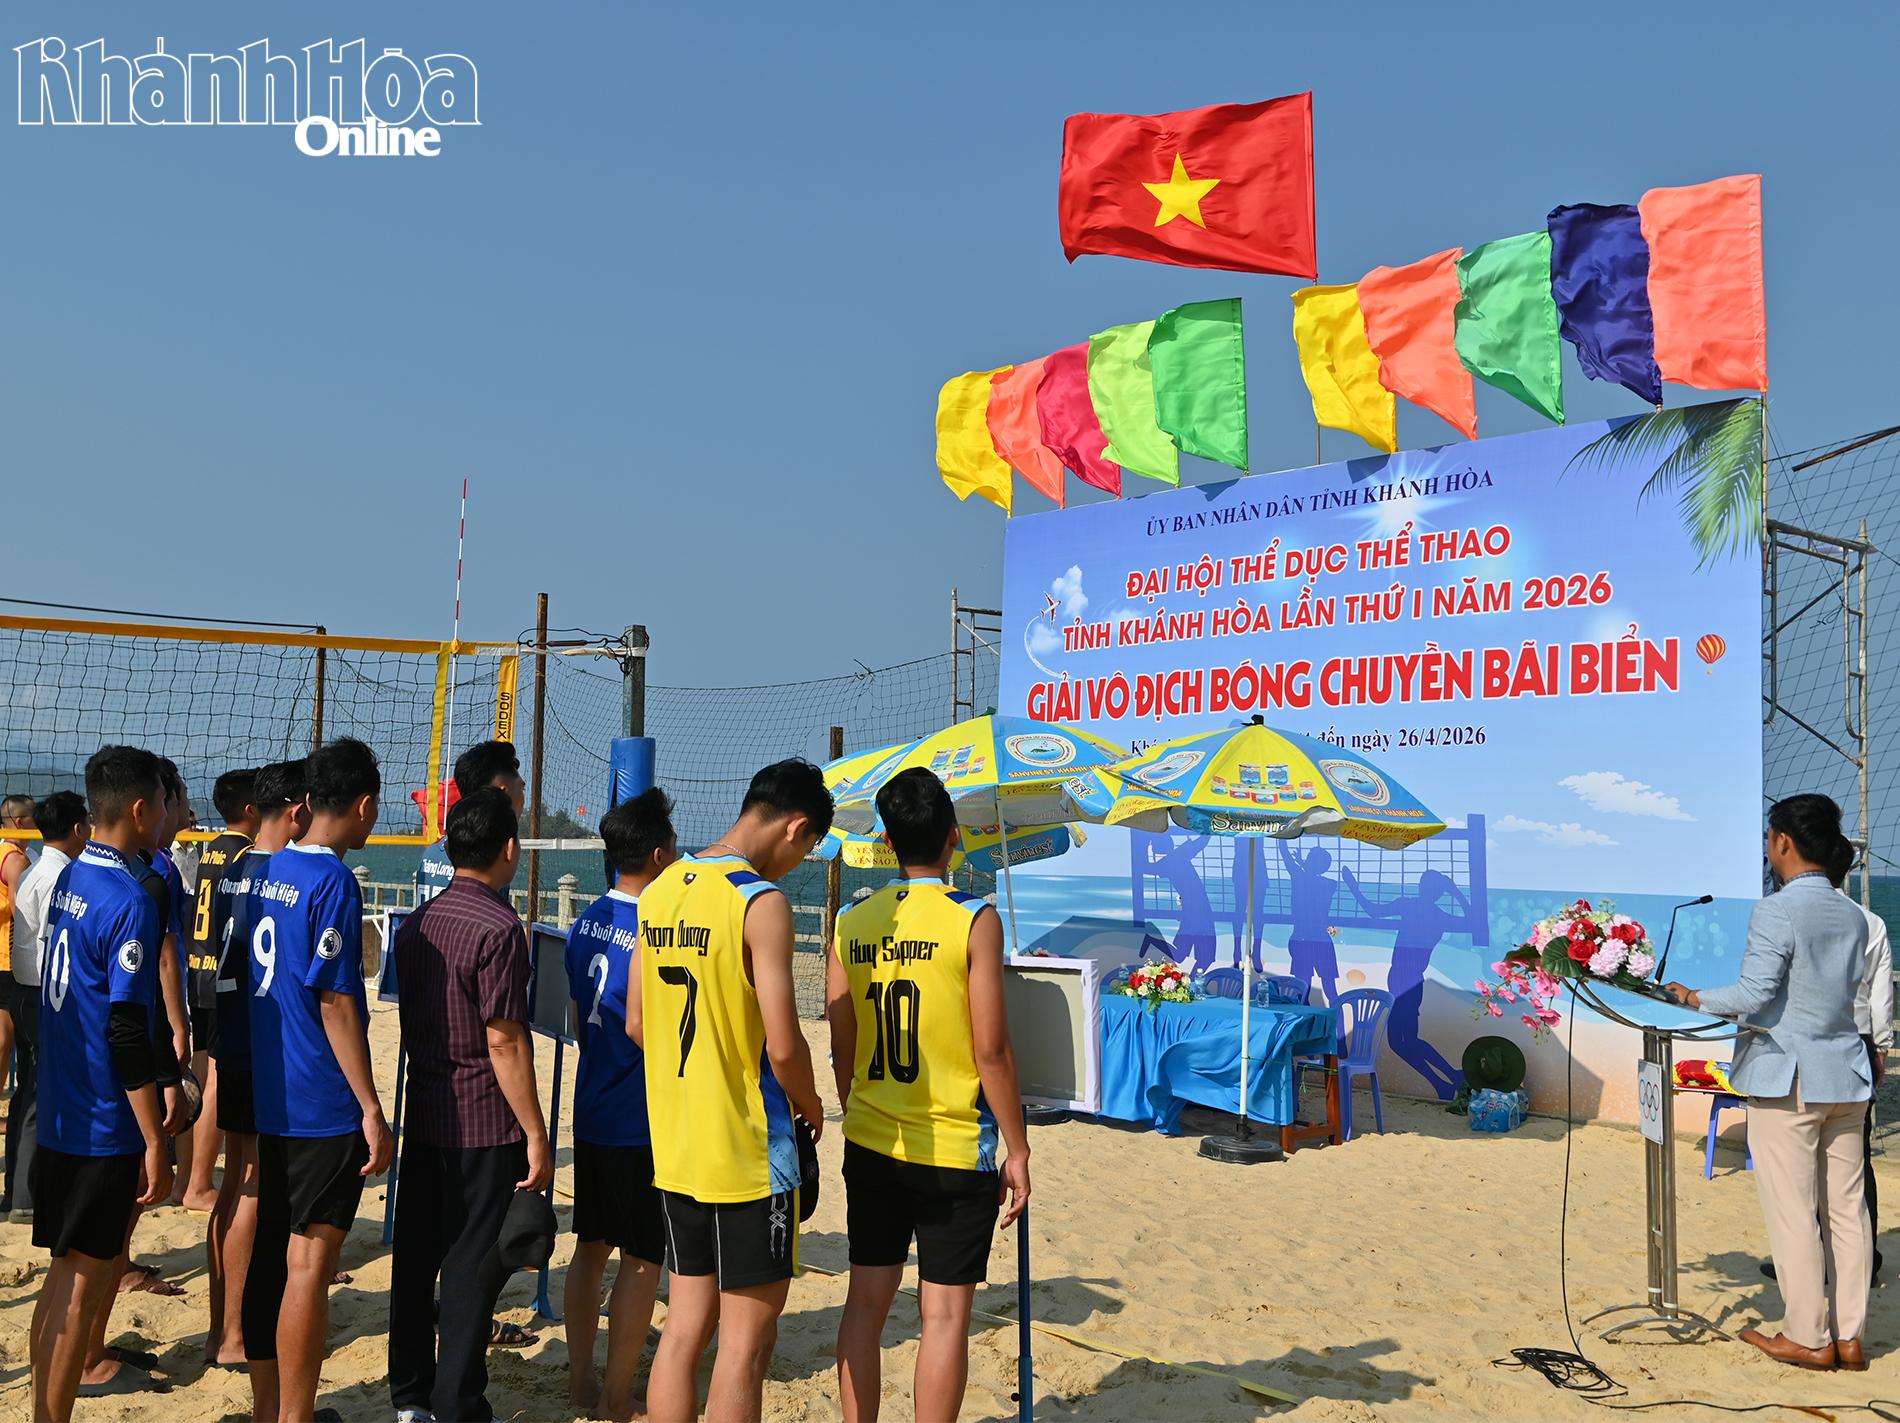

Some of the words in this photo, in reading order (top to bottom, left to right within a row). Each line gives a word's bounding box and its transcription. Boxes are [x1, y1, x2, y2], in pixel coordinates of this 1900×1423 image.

[1146, 511, 1169, 536] ỦY
[1173, 512, 1206, 532] BAN
[1210, 501, 1261, 526] NHÂN
[1265, 495, 1307, 519] DÂN
[1309, 487, 1358, 511] TỈNH
[1363, 477, 1439, 504] KHÁNH
[1444, 466, 1493, 492] HÒA
[1127, 568, 1169, 602] ĐẠI
[1176, 554, 1223, 597] HỘI
[1231, 538, 1281, 584] THỂ
[1284, 545, 1347, 584] DỤC
[1357, 520, 1413, 571] THỂ
[1420, 525, 1511, 564] THAO
[1063, 616, 1111, 652] TỈNH
[1118, 607, 1204, 646] KHÁNH
[1212, 599, 1271, 636] HÒA
[1280, 586, 1336, 631] LẦN
[1345, 582, 1405, 625] THỨ
[1412, 589, 1422, 618] I
[1433, 576, 1512, 618] NĂM
[1523, 571, 1613, 610] 2026
[1027, 671, 1081, 722] GIẢI
[1087, 671, 1131, 721] VÔ
[1134, 668, 1203, 721] ĐỊCH
[1209, 660, 1312, 713] BÓNG
[1319, 641, 1473, 708] CHUYỀN
[1483, 640, 1560, 700] BÃI
[1569, 622, 1680, 696] BIỂN
[497, 692, 510, 739] SODEX
[1351, 729, 1393, 752] ngày
[1398, 726, 1486, 748] 26/4/2026
[216, 916, 237, 993] 2
[253, 916, 276, 997] 9
[587, 953, 609, 1028] 2
[658, 966, 698, 1078] 7
[865, 979, 920, 1083] 10
